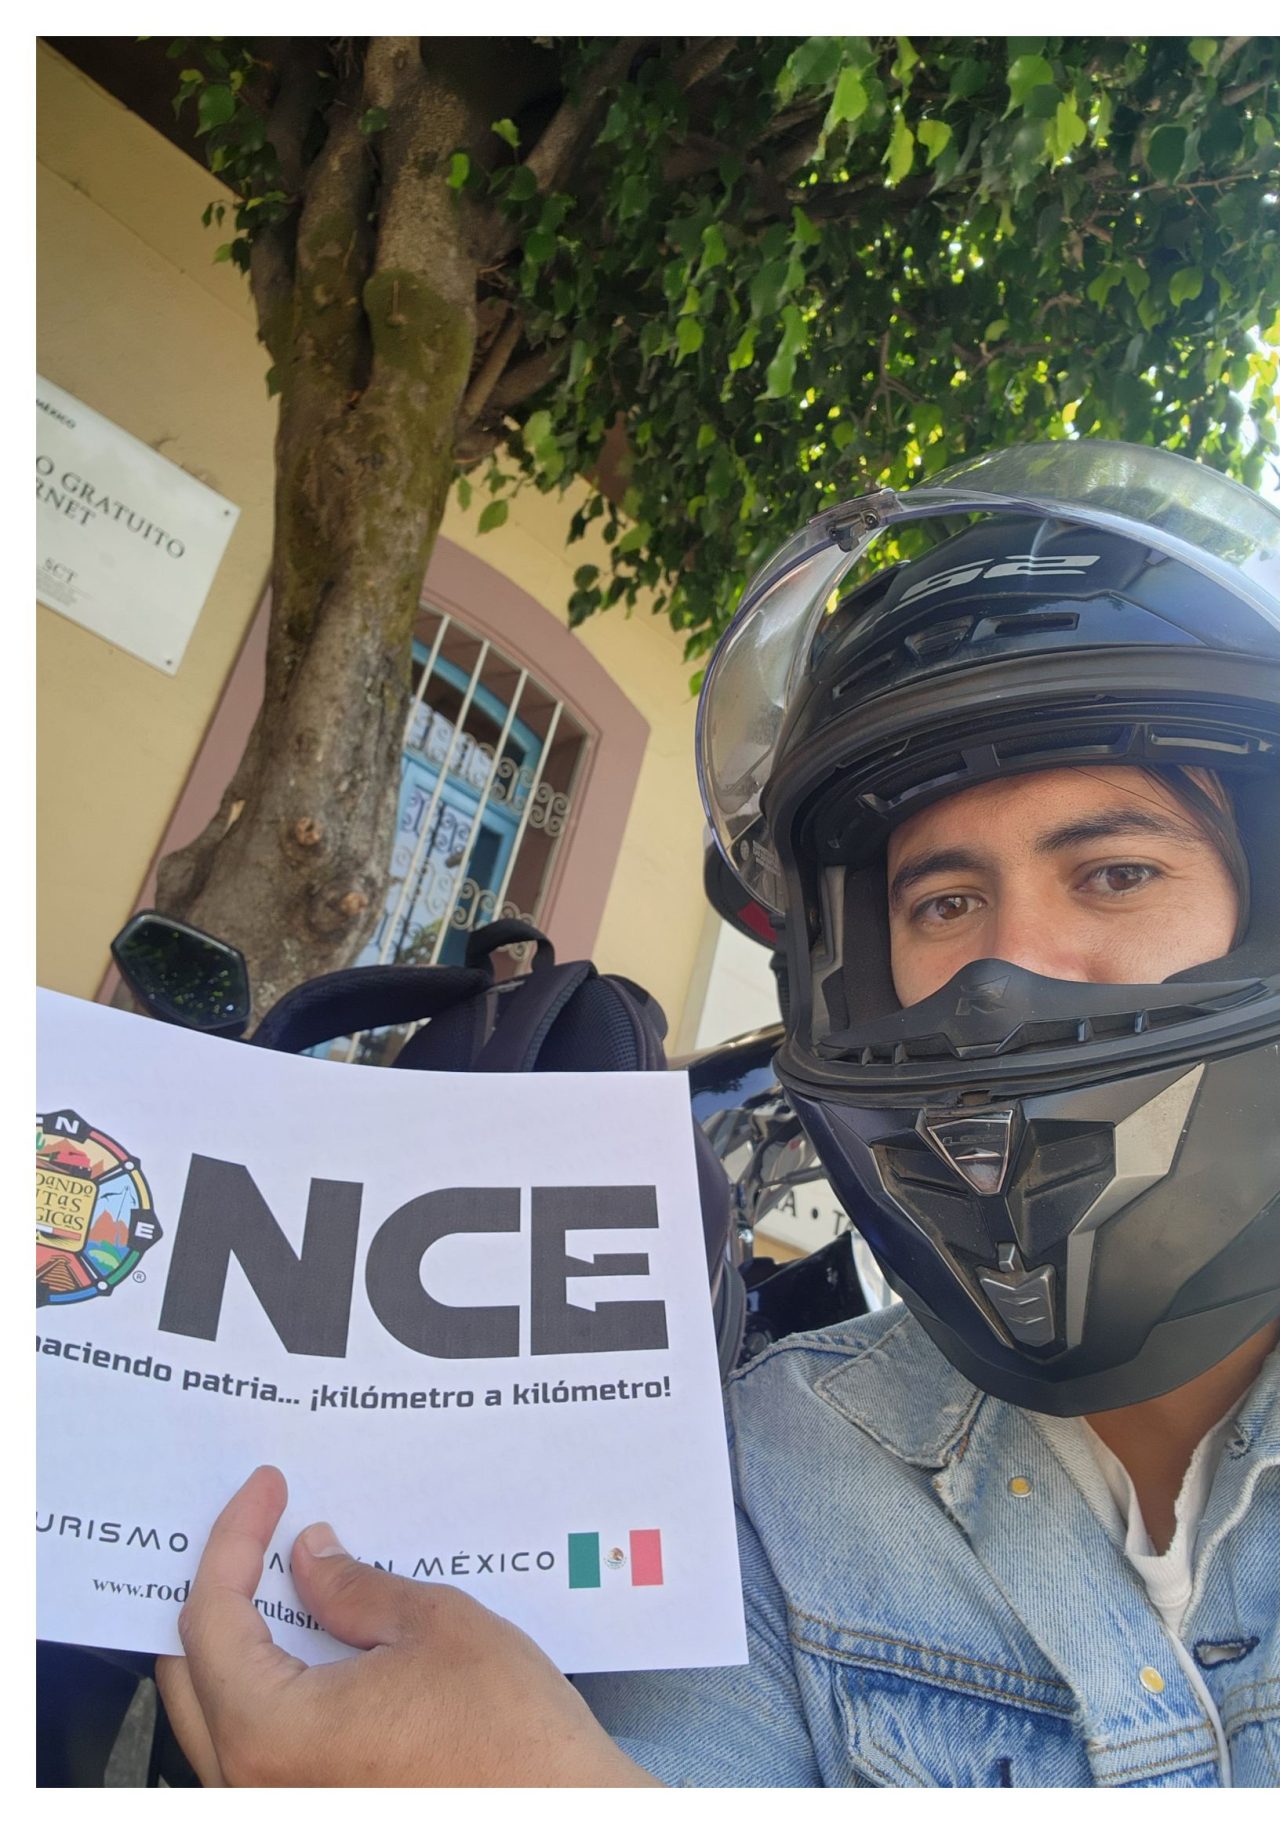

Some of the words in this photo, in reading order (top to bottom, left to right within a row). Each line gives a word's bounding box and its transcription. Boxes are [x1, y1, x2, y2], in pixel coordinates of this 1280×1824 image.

[61, 471, 186, 559] GRATUITO
[158, 1152, 670, 1360] NCE
[182, 1368, 300, 1405] patria...
[309, 1384, 475, 1412] ¡kilómetro
[484, 1388, 502, 1407] a
[512, 1375, 672, 1406] kilómetro!
[36, 1511, 189, 1553] URISMO
[412, 1550, 556, 1578] MÉXICO
